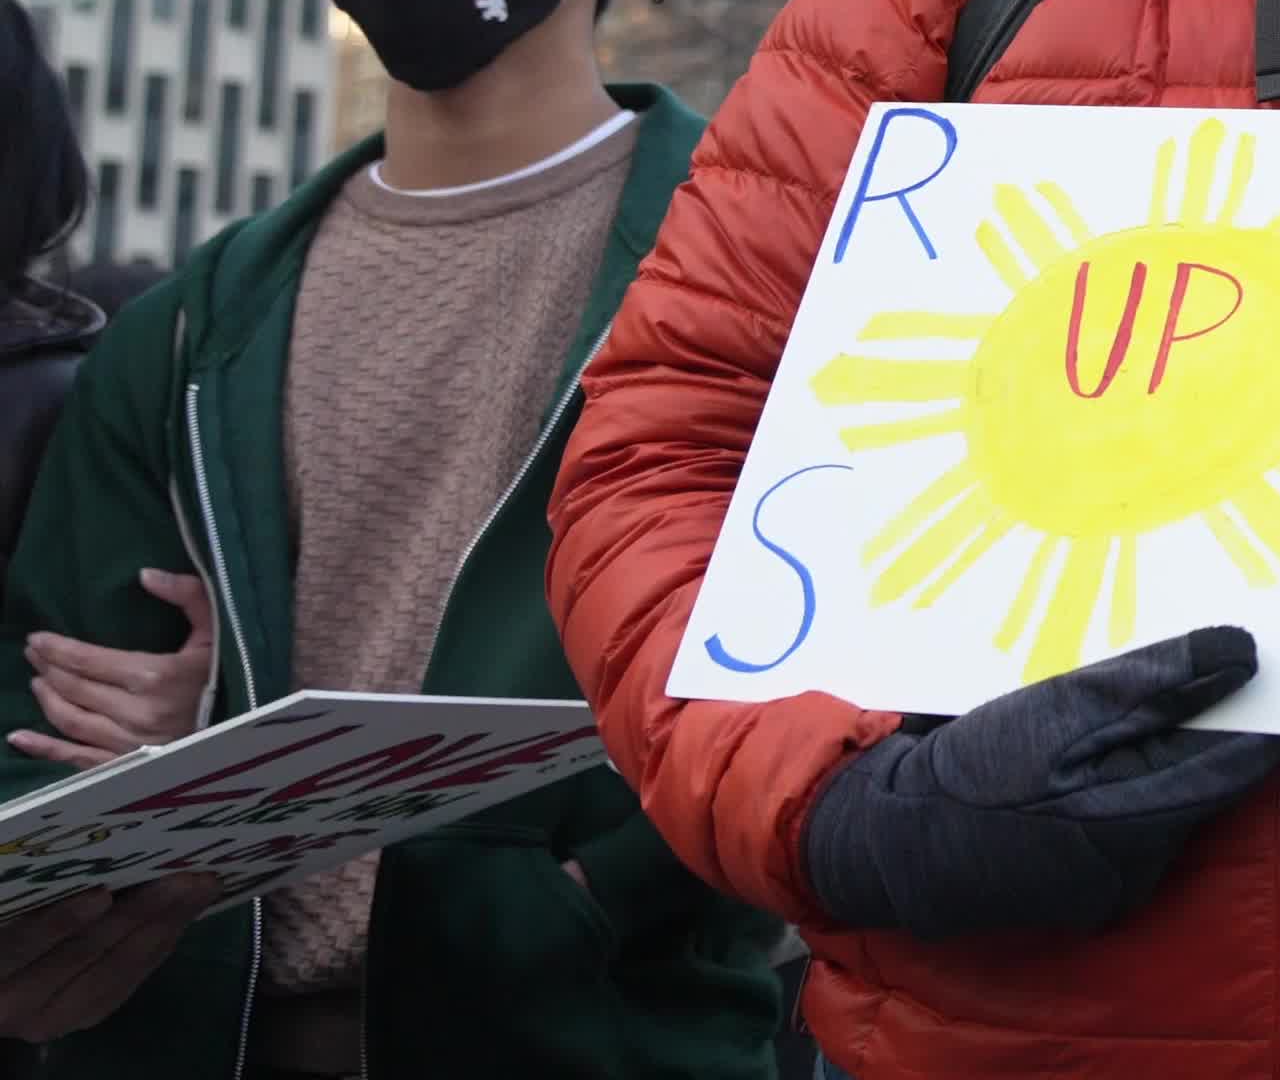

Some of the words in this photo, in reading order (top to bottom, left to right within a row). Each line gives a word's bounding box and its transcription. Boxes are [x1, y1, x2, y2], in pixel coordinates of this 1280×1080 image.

[832, 107, 958, 262] R
[1062, 261, 1244, 398] UP
[703, 464, 854, 673] S
